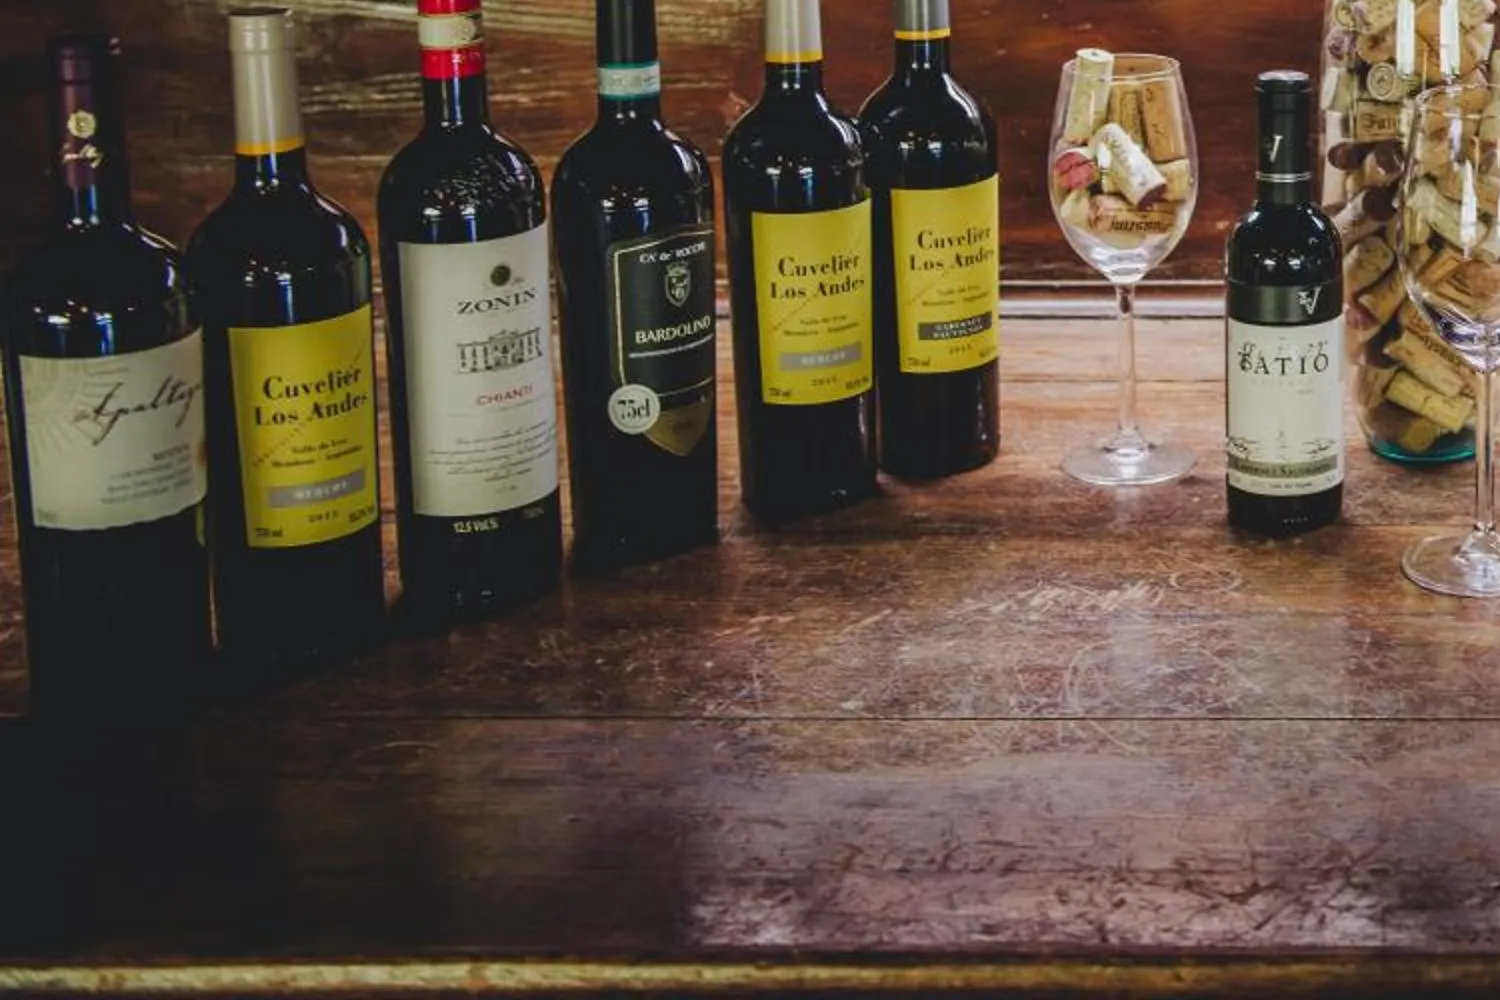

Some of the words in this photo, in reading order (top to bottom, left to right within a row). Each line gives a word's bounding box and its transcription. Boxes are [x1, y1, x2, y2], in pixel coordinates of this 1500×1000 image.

[917, 226, 991, 250] Cuvelier
[777, 254, 861, 278] Cuvelier
[909, 254, 945, 272] Los
[456, 287, 537, 315] ZONIN
[769, 281, 807, 300] Los
[634, 315, 712, 345] BARDOLINO
[262, 367, 362, 401] Cuvelier
[476, 384, 534, 406] CHIANTI
[254, 405, 299, 426] Los
